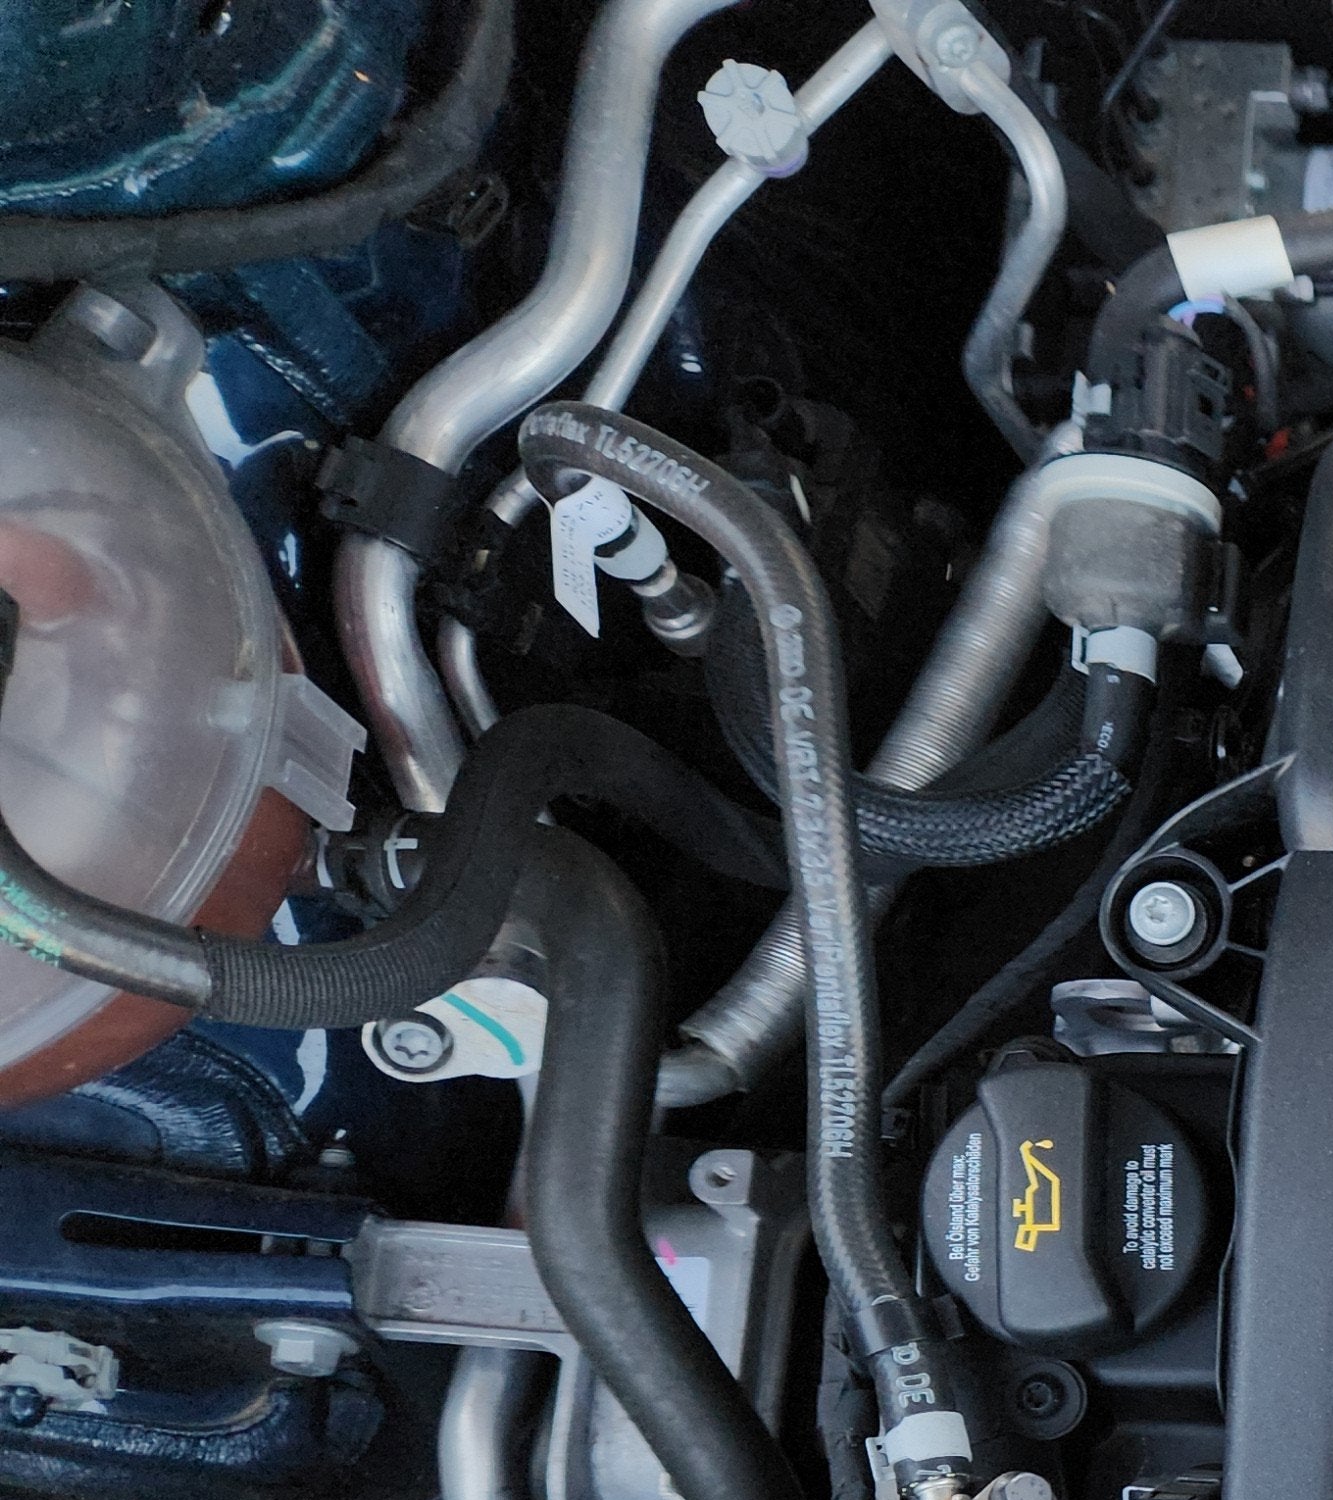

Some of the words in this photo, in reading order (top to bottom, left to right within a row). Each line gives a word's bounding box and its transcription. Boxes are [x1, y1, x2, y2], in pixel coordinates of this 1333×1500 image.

[820, 1055, 856, 1158] TL52706H
[1123, 1160, 1138, 1170] to
[1141, 1144, 1156, 1168] must
[1157, 1143, 1173, 1168] mark
[964, 1133, 983, 1226] Katalysatorschäden
[1140, 1170, 1155, 1182] oil
[946, 1180, 965, 1202] über
[1123, 1172, 1141, 1211] damage
[1158, 1169, 1173, 1216] maximum
[1141, 1183, 1156, 1228] converter
[945, 1204, 965, 1241] Ölstand
[1122, 1213, 1138, 1239] avoid
[1157, 1218, 1173, 1252] exceed
[967, 1228, 980, 1245] von
[1122, 1241, 1138, 1254] To
[949, 1243, 965, 1260] Bei
[1140, 1230, 1158, 1270] catalytic
[1157, 1254, 1174, 1271] not
[964, 1248, 980, 1281] Gefahr
